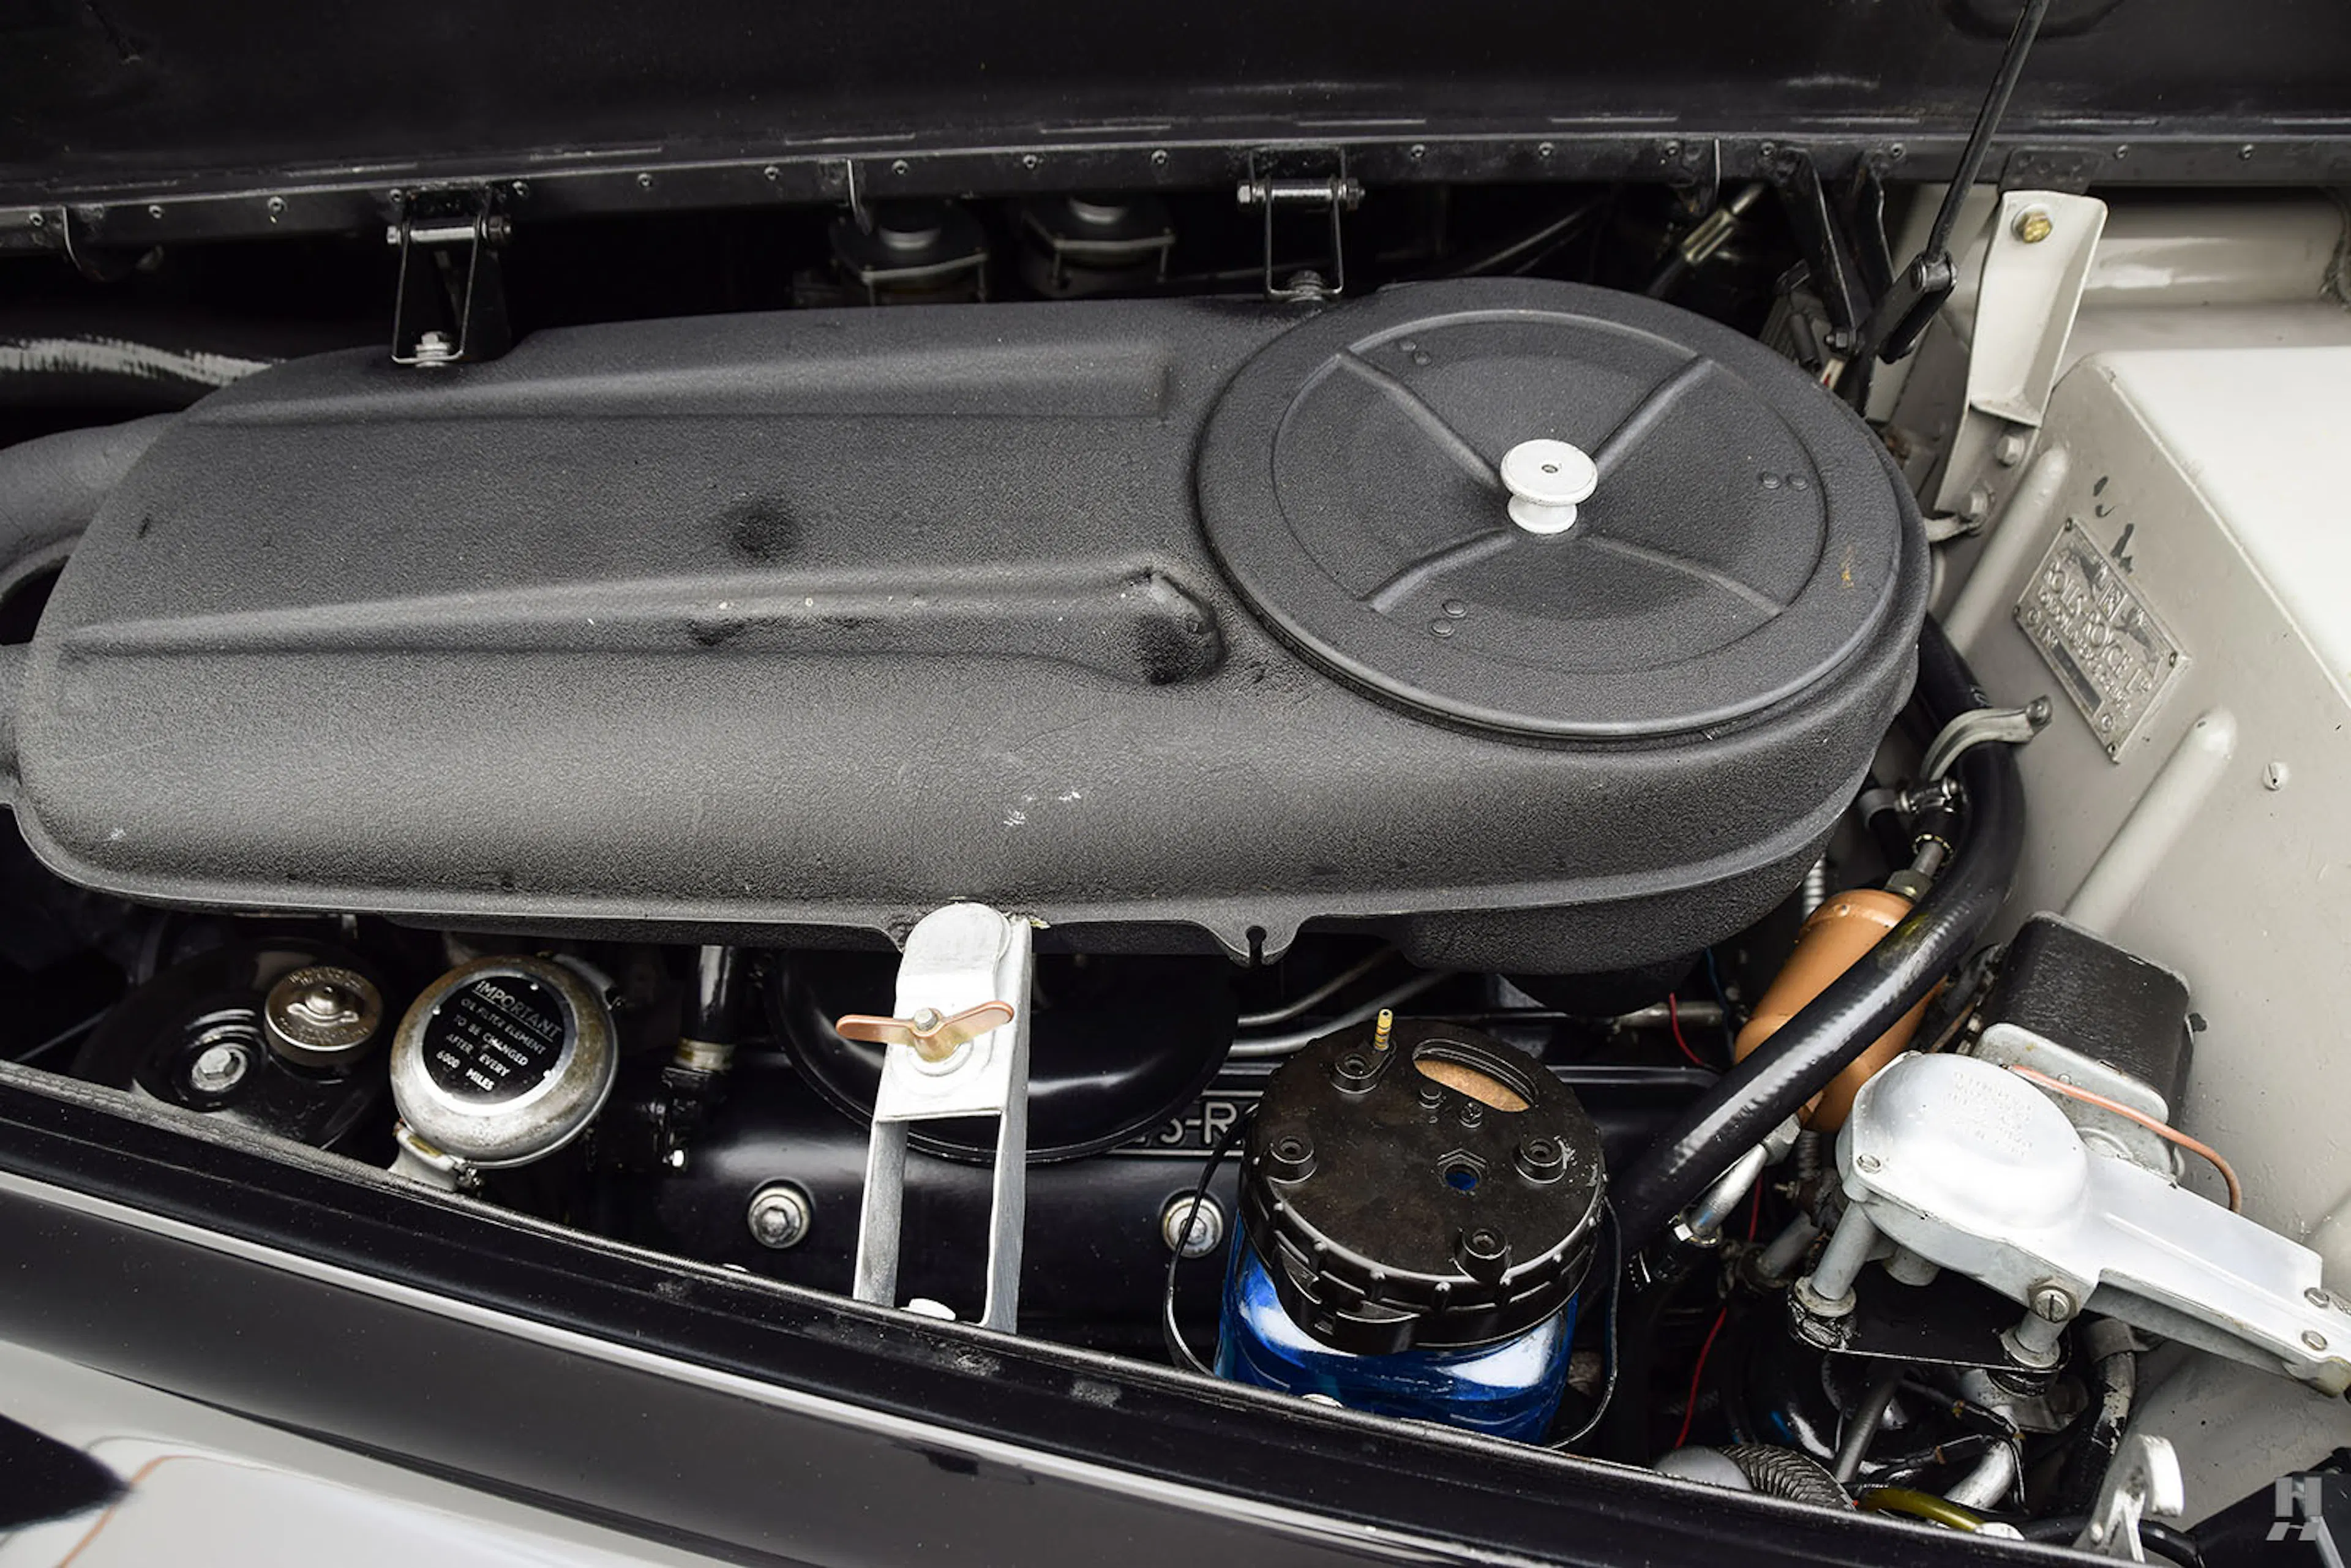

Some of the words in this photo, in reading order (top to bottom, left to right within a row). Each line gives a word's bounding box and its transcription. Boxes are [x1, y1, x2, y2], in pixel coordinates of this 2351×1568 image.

[461, 999, 476, 1011] OIL
[476, 1007, 505, 1027] FILTER
[504, 1024, 546, 1054] ELEMENT
[475, 980, 561, 1037] IMPORTANT
[446, 1034, 474, 1054] AFTER
[479, 1054, 511, 1076] EVERY
[454, 1015, 467, 1026] TO
[468, 1024, 481, 1035] BE
[483, 1033, 528, 1066] CHANGED
[437, 1051, 460, 1068] 6000
[466, 1068, 495, 1091] MILES
